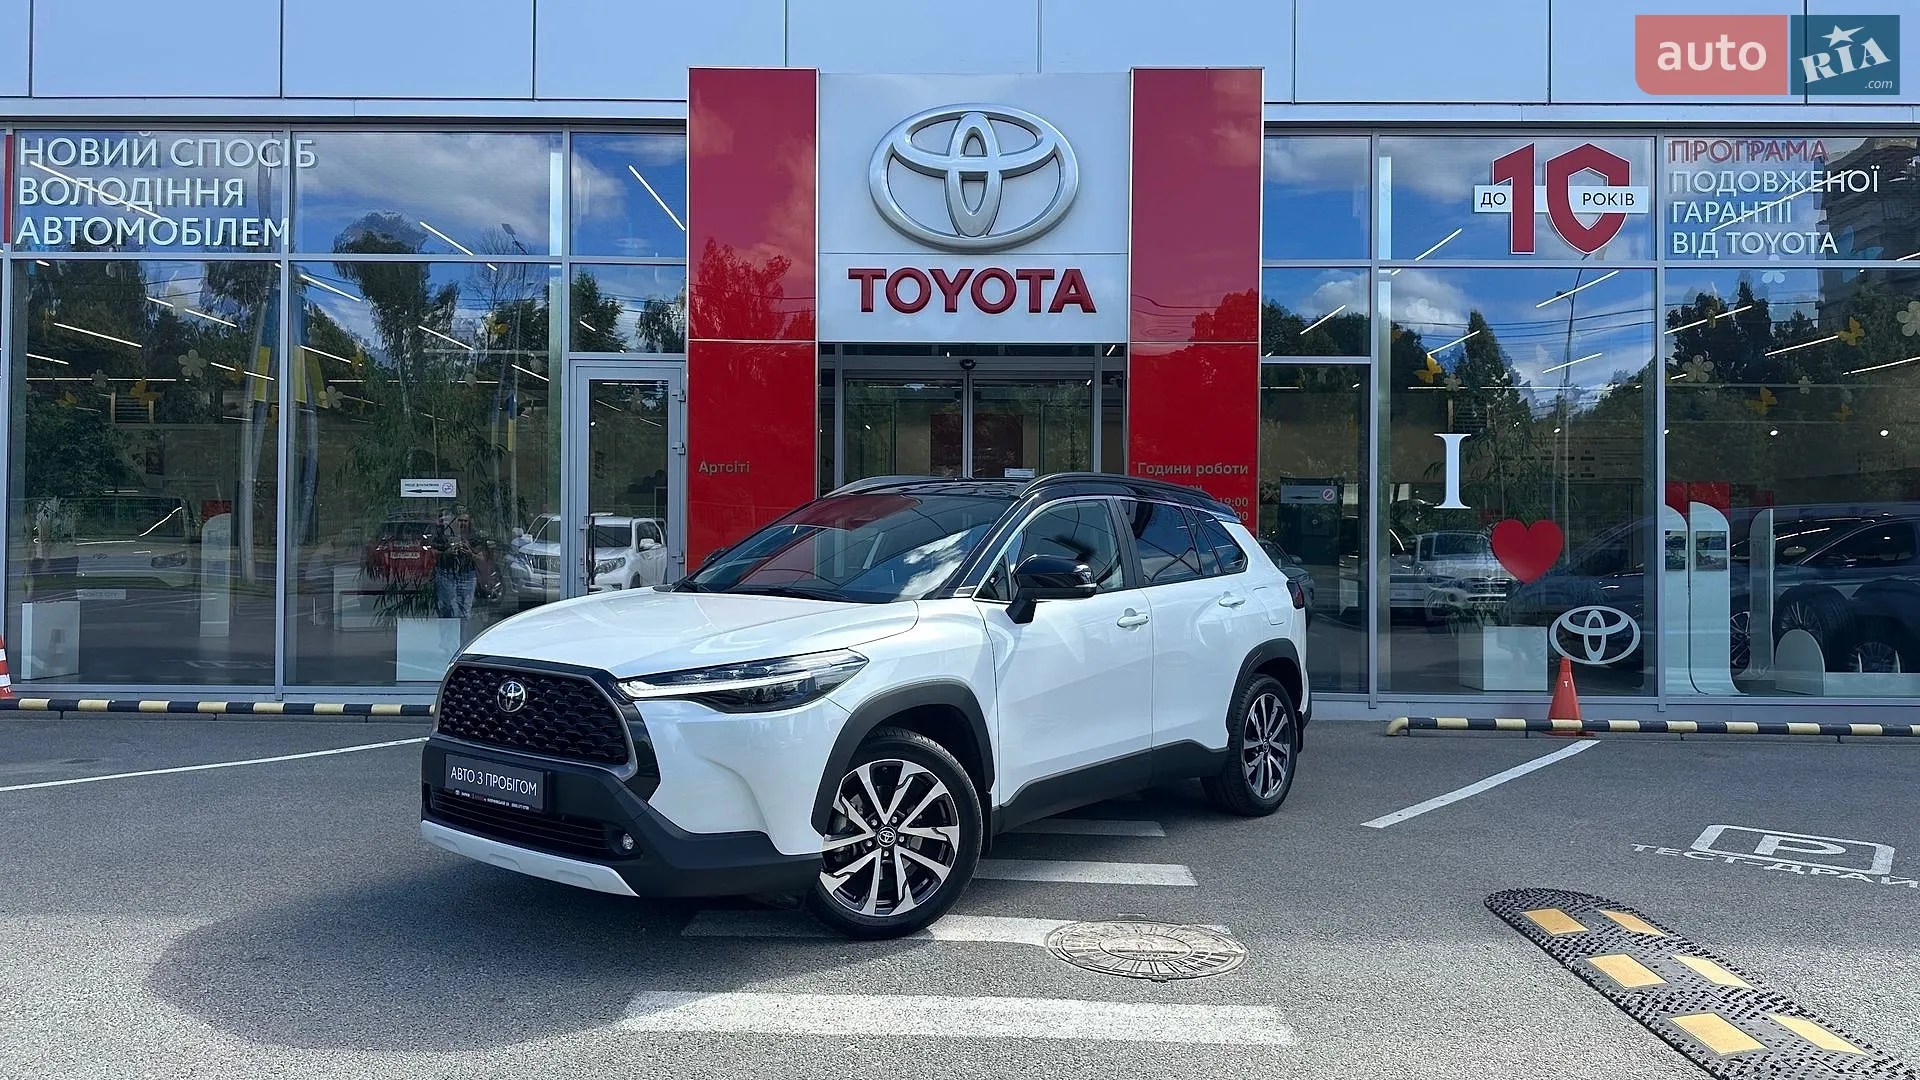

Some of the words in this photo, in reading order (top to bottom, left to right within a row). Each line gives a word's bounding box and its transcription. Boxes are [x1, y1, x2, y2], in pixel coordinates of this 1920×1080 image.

[20, 130, 157, 166] НОВИЙ
[170, 138, 316, 168] СПОСІБ
[1671, 139, 1829, 162] ПРОГРАМА
[19, 177, 244, 211] ВОЛОДІННЯ
[1674, 164, 1881, 197] ПОДОВЖЕНОЇ
[1480, 192, 1507, 207] ДО
[1582, 192, 1635, 206] РОКІВ
[16, 216, 289, 247] АВТОМОБІЛЕМ
[1673, 231, 1718, 257] ВІД
[1726, 232, 1839, 254] TOYOTA
[848, 267, 1097, 314] TOYOTA
[699, 460, 750, 476] Артсіті
[1137, 462, 1192, 477] Години
[1196, 462, 1249, 477] роботи
[1433, 433, 1472, 509] I
[450, 766, 476, 783] АВТО
[485, 773, 537, 797] ПРОБІГОМ
